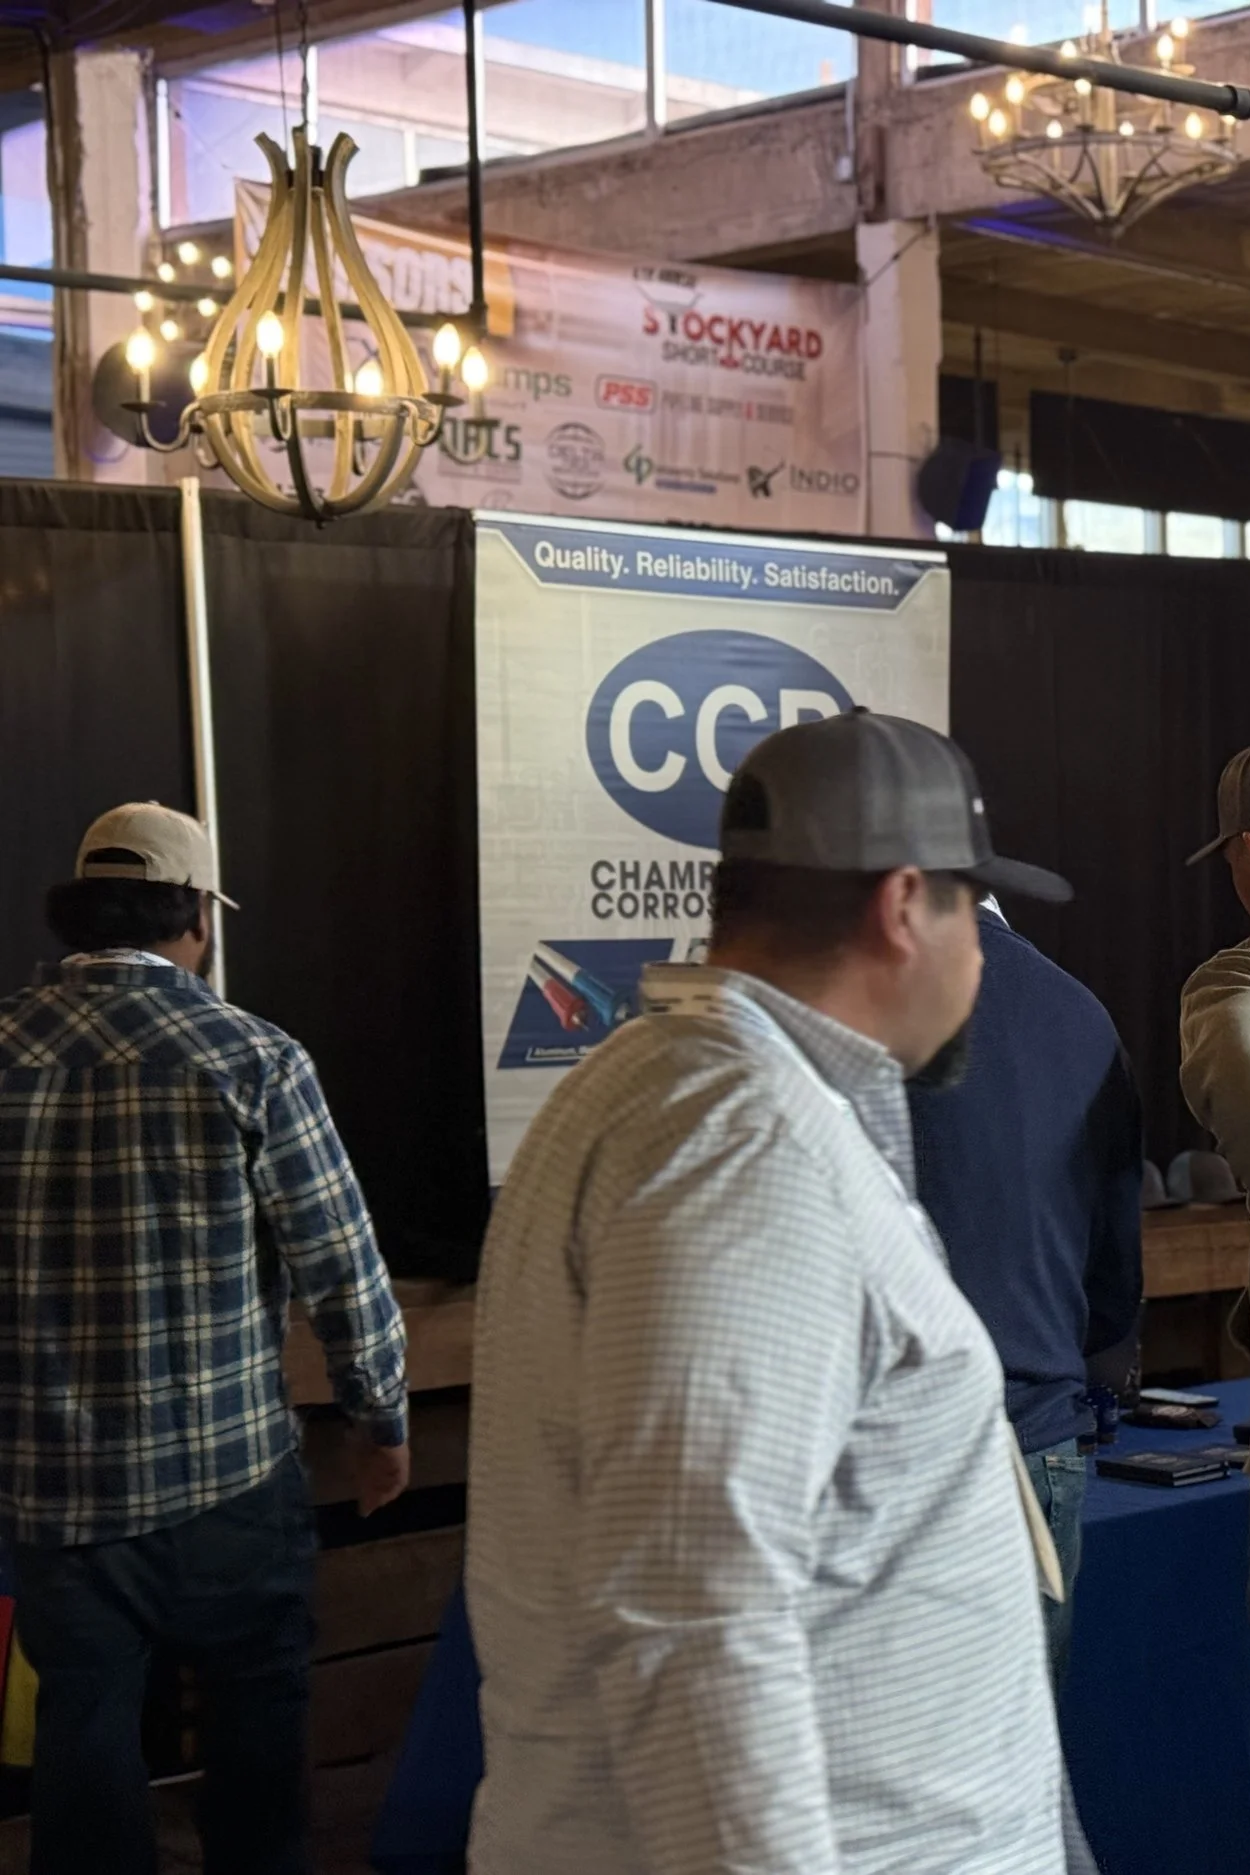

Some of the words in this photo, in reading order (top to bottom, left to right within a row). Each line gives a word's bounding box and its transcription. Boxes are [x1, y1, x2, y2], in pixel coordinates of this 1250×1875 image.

[643, 301, 824, 361] STOCKYARD
[602, 381, 653, 409] PSS
[790, 464, 860, 495] INDIO
[534, 540, 630, 579] Quality.
[636, 551, 759, 590] Reliability.
[764, 562, 900, 597] Satisfaction.
